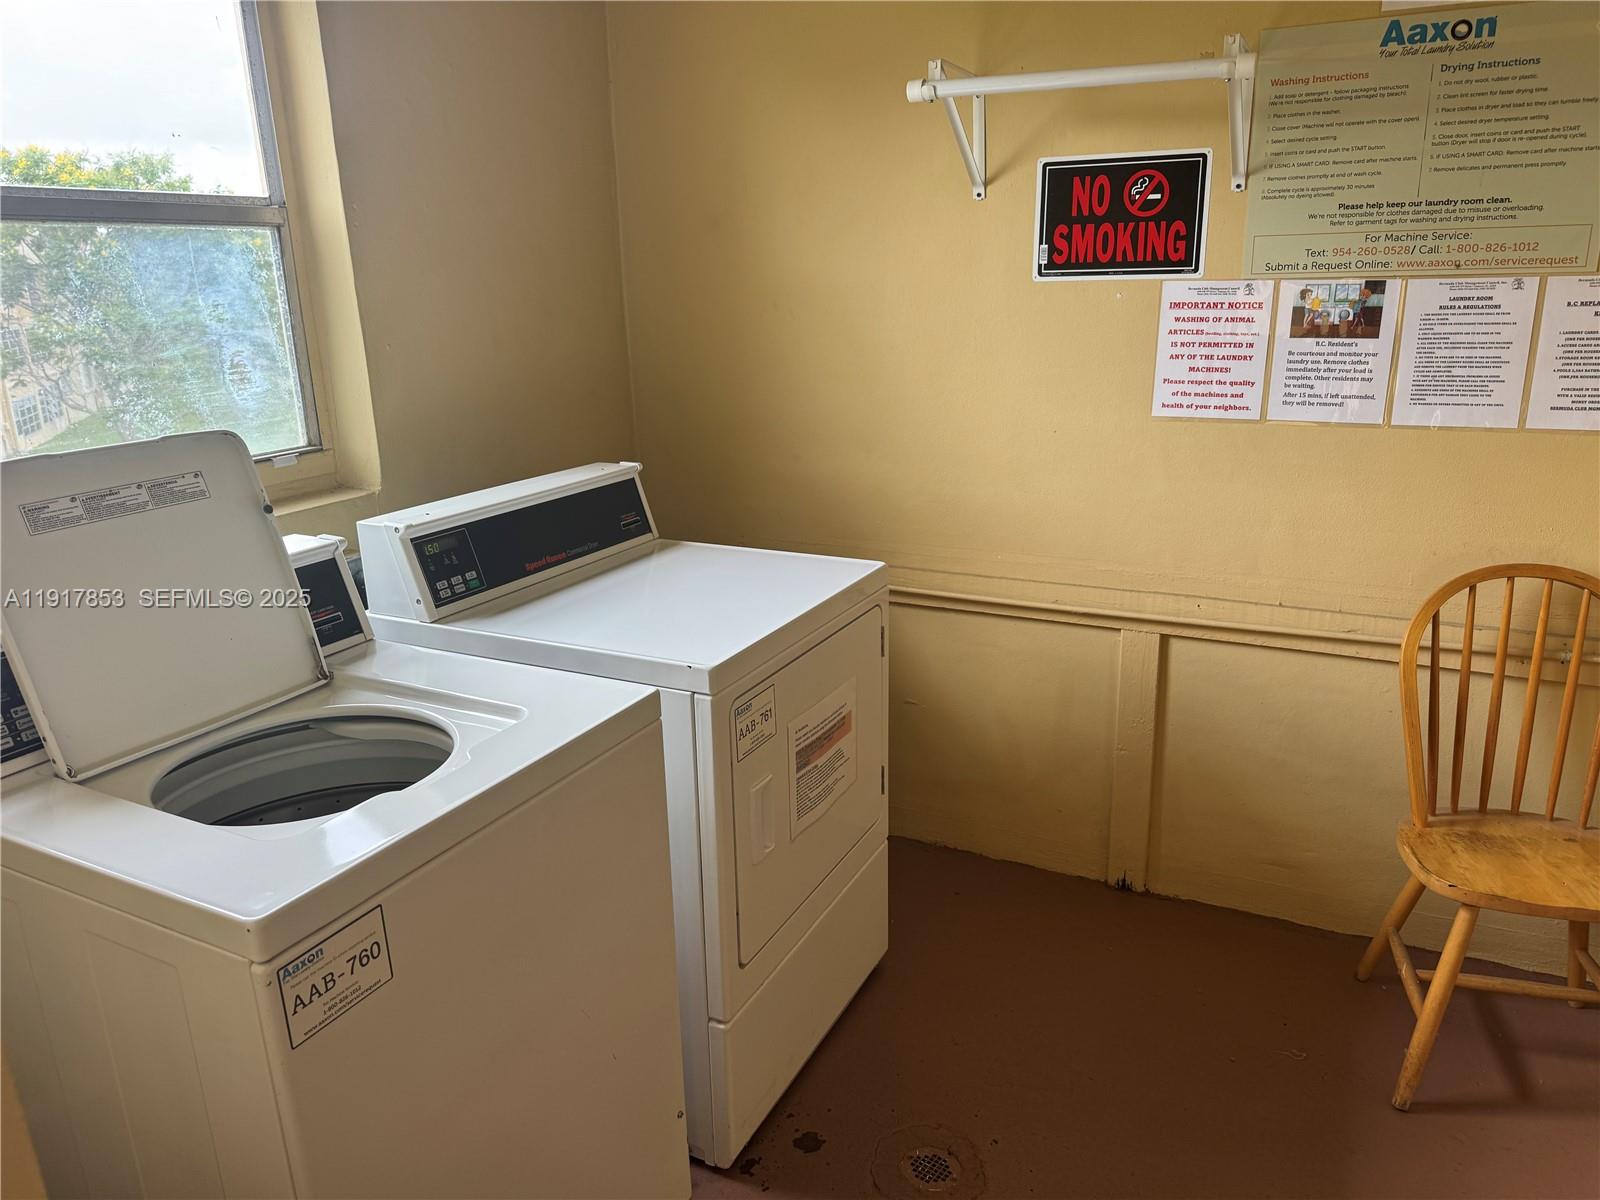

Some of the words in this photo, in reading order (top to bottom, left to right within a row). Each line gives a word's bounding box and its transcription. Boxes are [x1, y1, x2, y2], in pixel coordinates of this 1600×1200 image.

[1380, 16, 1497, 48] Aaxon
[1379, 48, 1399, 57] Your
[1400, 46, 1421, 56] Total
[1421, 44, 1456, 57] Laundry
[1456, 41, 1495, 52] Solution
[1440, 62, 1475, 75] Drying
[1477, 57, 1541, 70] Instructions
[1270, 76, 1310, 89] Washing
[1312, 72, 1369, 84] Instructions
[1072, 174, 1110, 216] NO
[1366, 202, 1384, 210] help
[1386, 201, 1406, 210] keep
[1425, 199, 1459, 208] laundry
[1338, 211, 1375, 220] responsible
[1411, 209, 1443, 217] damaged
[1355, 219, 1383, 227] garment
[1384, 218, 1398, 226] tags
[1410, 217, 1438, 225] washing
[1453, 215, 1475, 224] drying
[1052, 220, 1187, 264] SMOKING
[1365, 234, 1382, 243] For
[1384, 232, 1429, 242] Machine
[1432, 231, 1473, 241] Service:
[1304, 248, 1329, 257] Text:
[1419, 245, 1443, 254] Call:
[1446, 242, 1539, 254] 1-800-826-1012
[1265, 262, 1300, 271] Submit
[1311, 261, 1352, 272] Request
[1355, 260, 1393, 269] Online:
[1397, 256, 1578, 269] www.aaxon.com/servicerequest
[1213, 404, 1251, 412] neighbors.
[739, 706, 772, 741] AAB-761
[282, 948, 324, 981] Aaxon
[292, 941, 381, 1016] AAB-760
